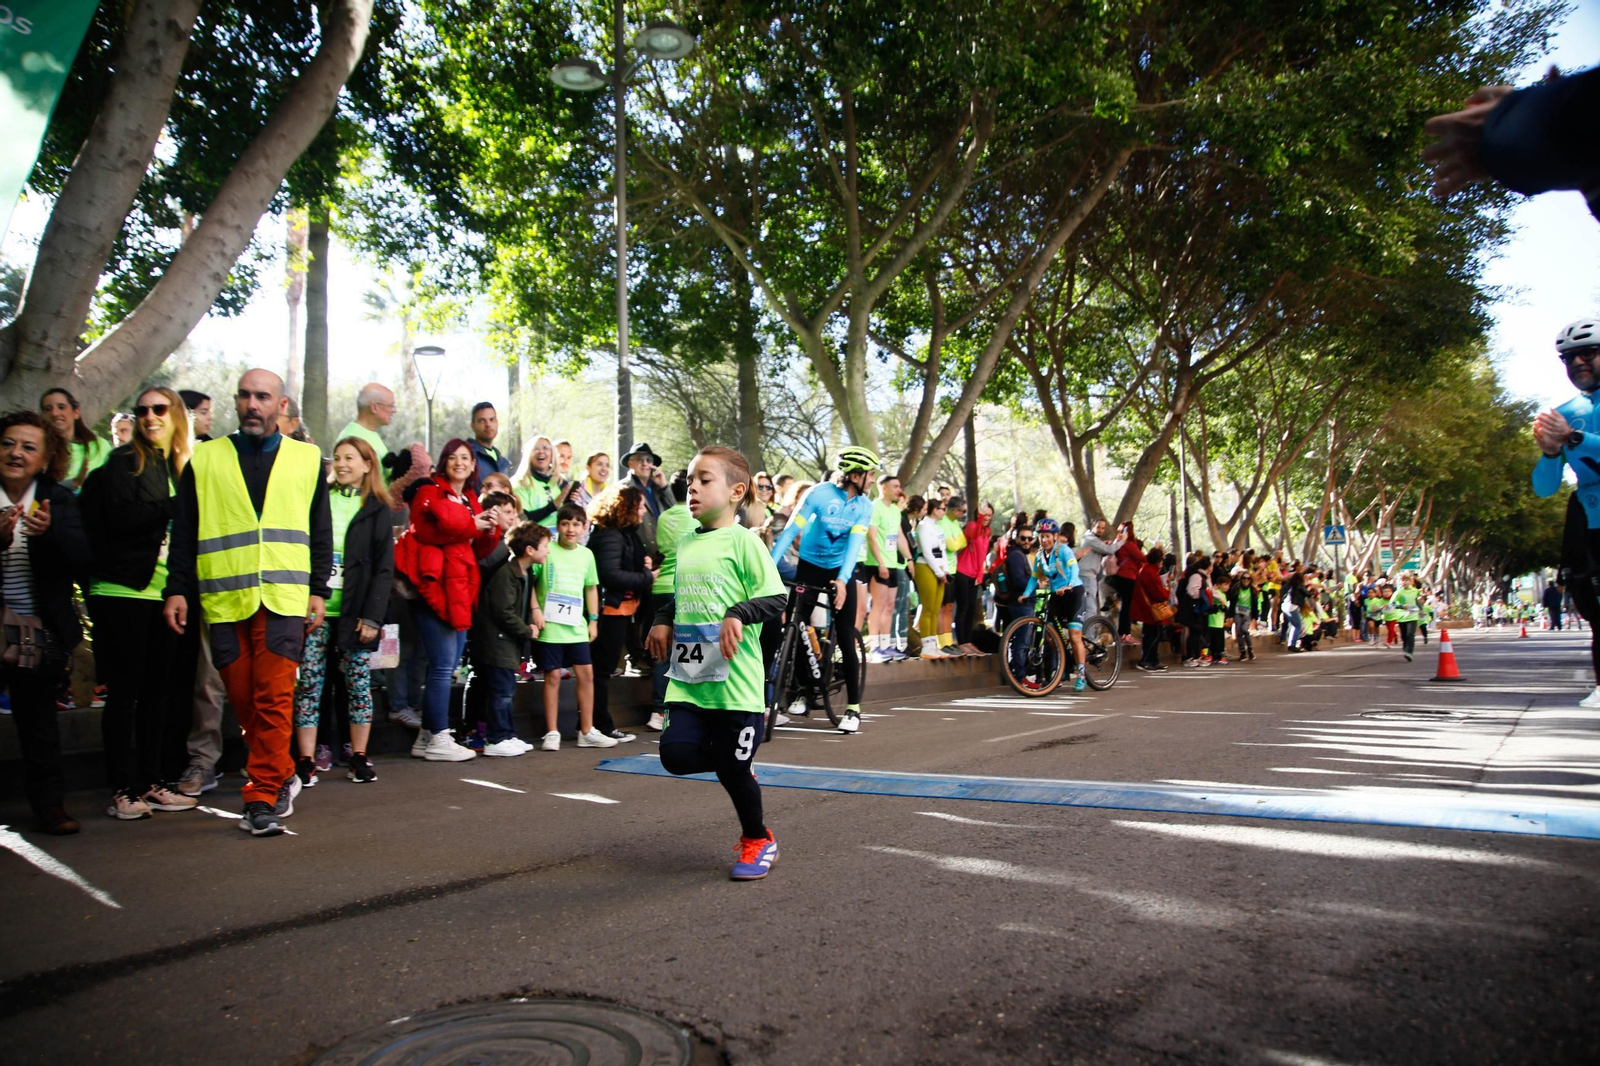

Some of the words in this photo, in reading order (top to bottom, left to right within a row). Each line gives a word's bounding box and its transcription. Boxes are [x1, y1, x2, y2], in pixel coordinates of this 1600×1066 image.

[686, 571, 725, 584] marcha
[712, 586, 724, 598] el
[558, 604, 571, 616] 71
[676, 643, 704, 663] 24
[735, 727, 755, 760] 9
